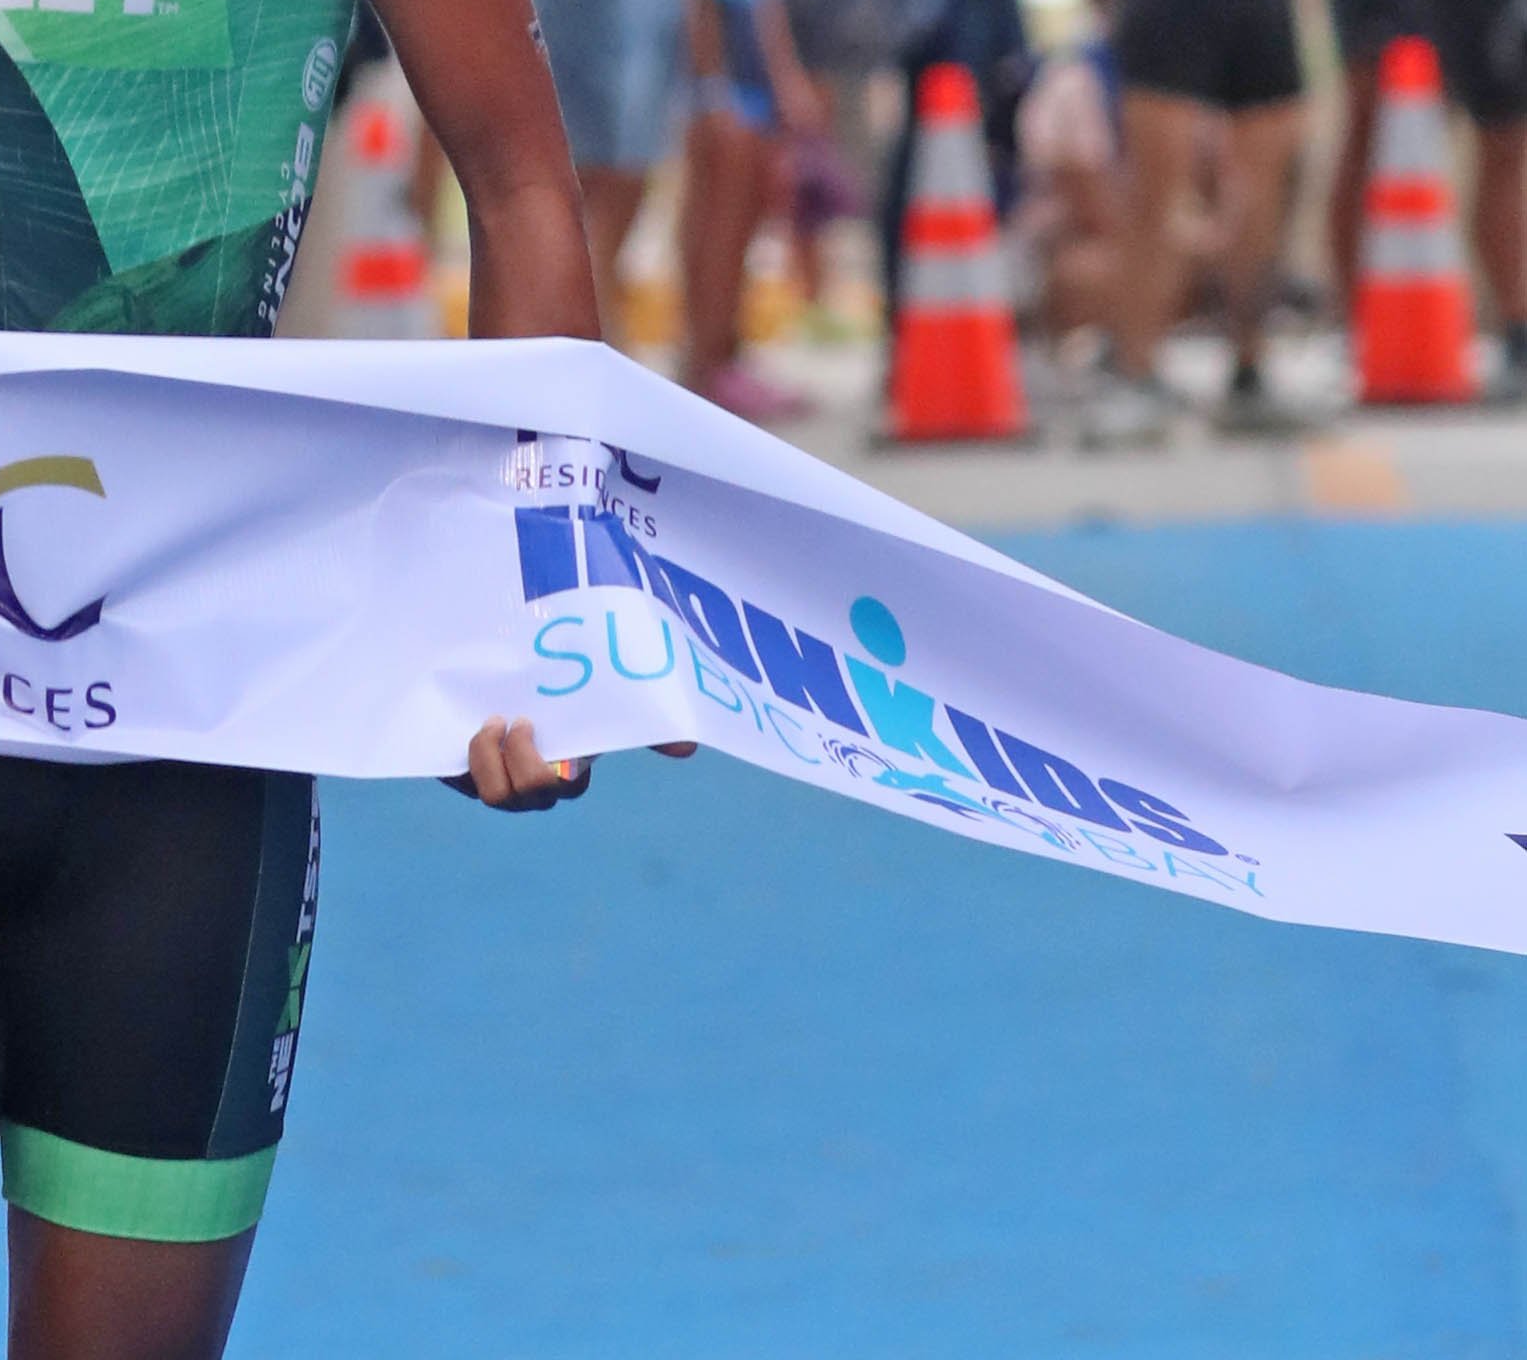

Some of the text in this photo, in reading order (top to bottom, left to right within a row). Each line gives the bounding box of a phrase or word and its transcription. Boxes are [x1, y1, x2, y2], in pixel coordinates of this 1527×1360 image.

[257, 161, 290, 320] CYCLING
[515, 462, 658, 539] RESIDNCES
[533, 610, 1266, 897] SUBIC BAY
